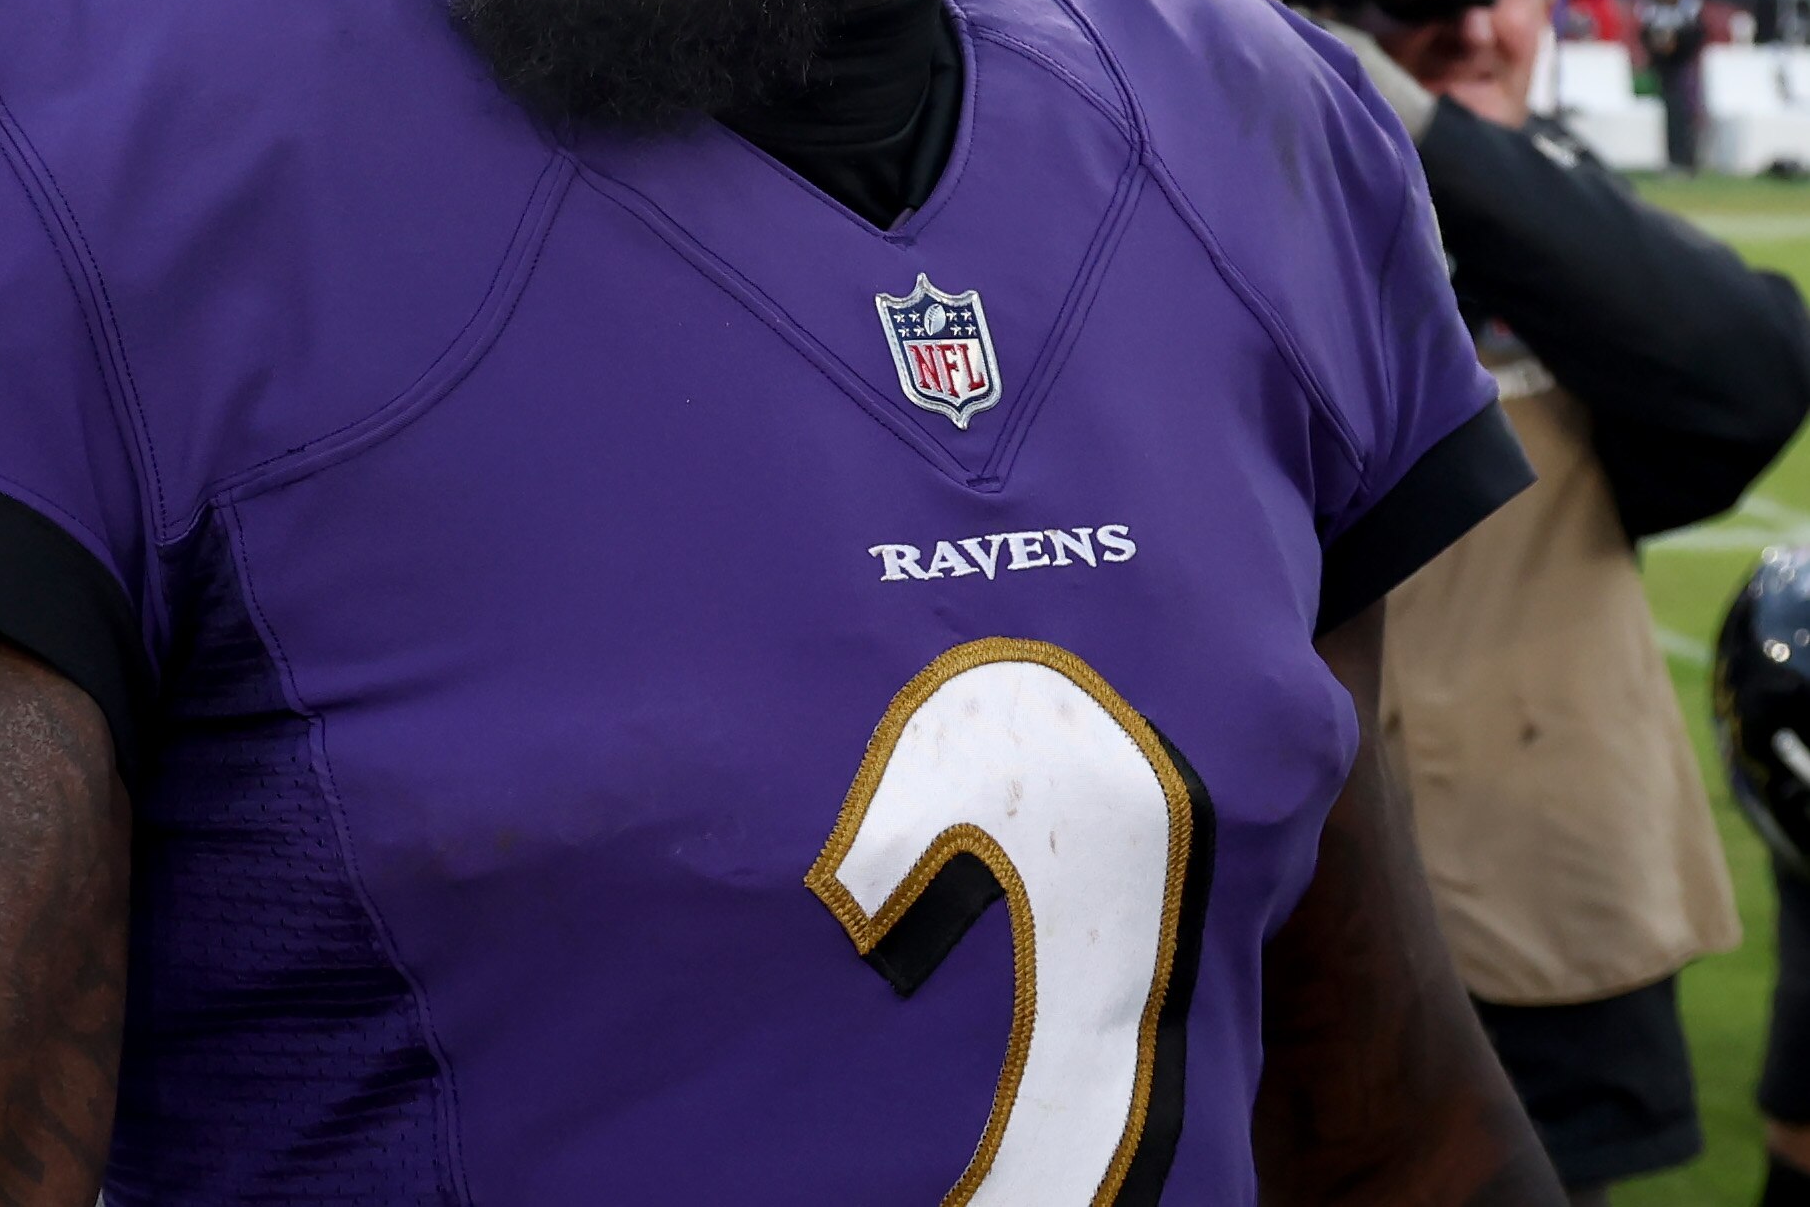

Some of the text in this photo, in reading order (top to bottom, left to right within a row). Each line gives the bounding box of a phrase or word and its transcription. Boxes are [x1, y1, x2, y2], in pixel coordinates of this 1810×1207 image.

[909, 344, 987, 399] NFL
[868, 524, 1138, 582] RAVENS
[803, 635, 1217, 1207] 2
